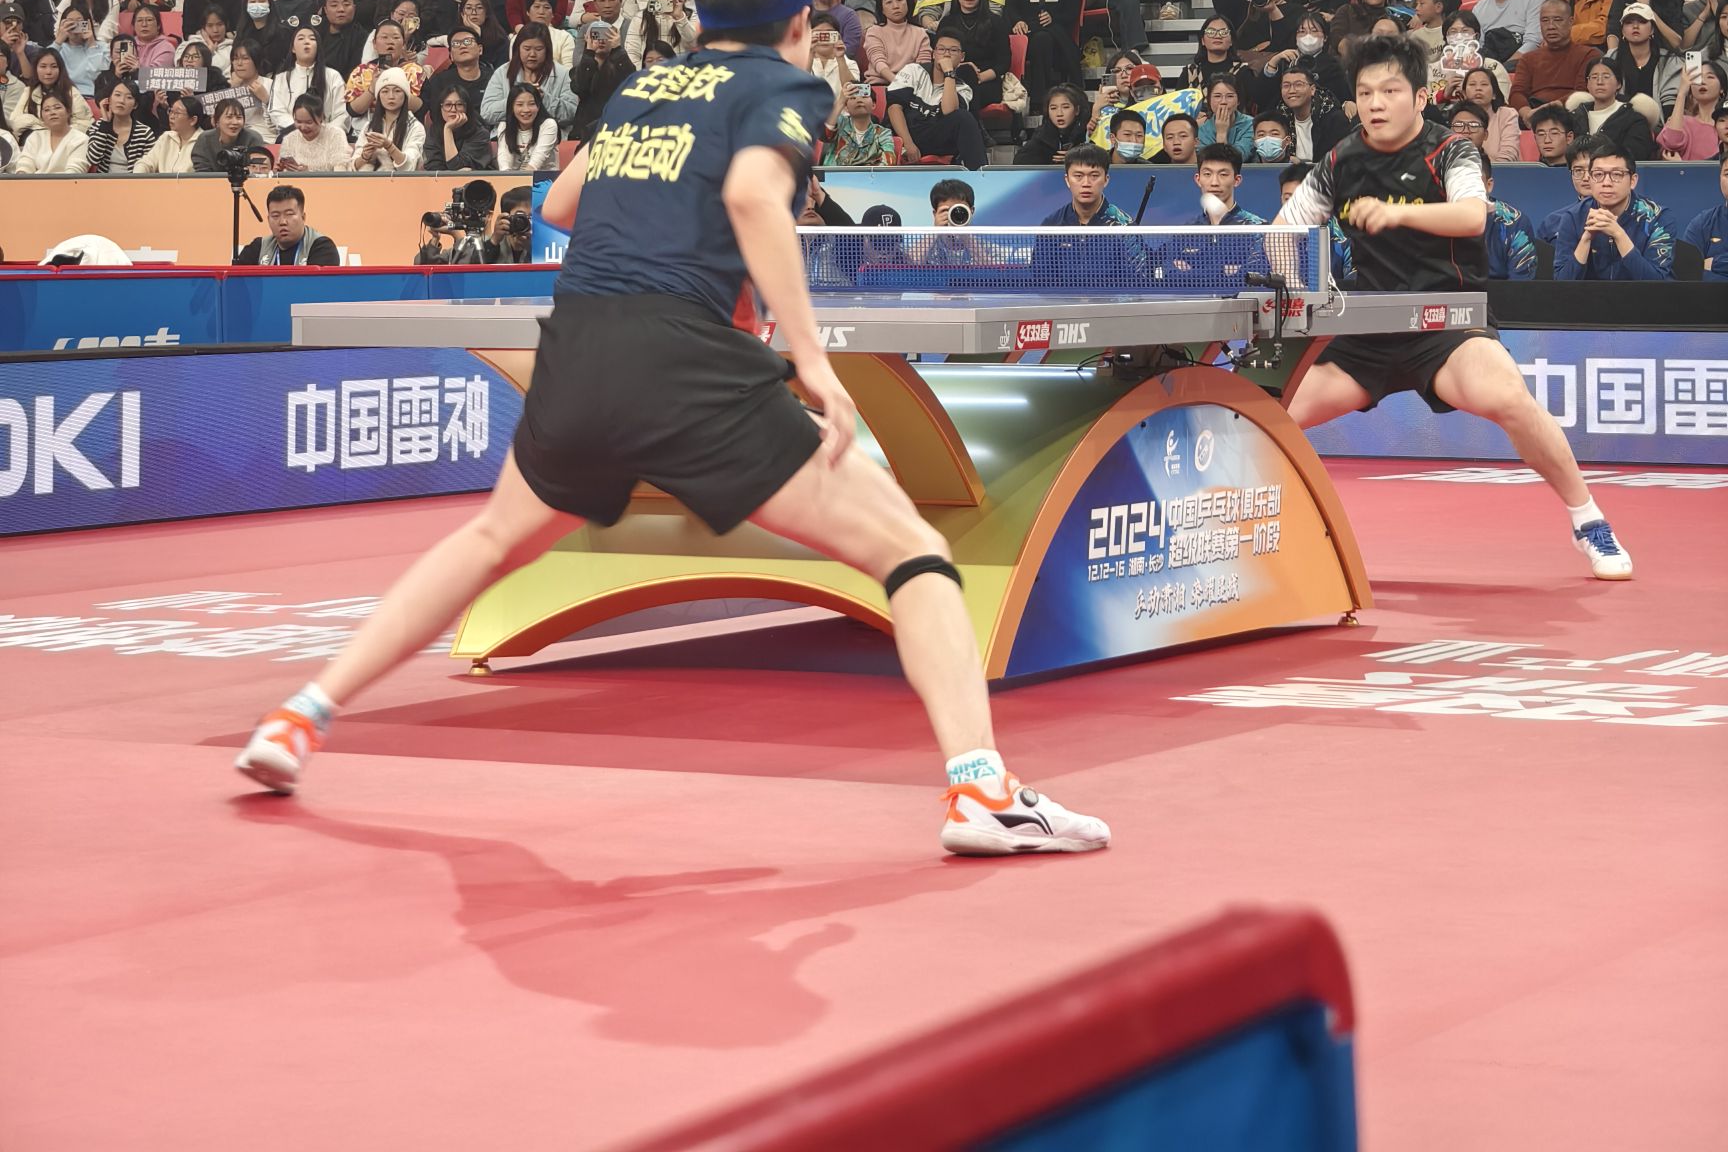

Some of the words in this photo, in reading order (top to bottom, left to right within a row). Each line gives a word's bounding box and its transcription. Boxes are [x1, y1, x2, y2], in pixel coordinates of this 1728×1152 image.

[621, 63, 736, 103] 王楚钦
[1018, 322, 1051, 349] 红双喜
[1056, 322, 1090, 345] DHS
[1450, 307, 1474, 325] DHS
[286, 374, 490, 473] 中国雷神
[1088, 499, 1168, 560] 2024
[1168, 484, 1282, 532] 中国乒乓球俱乐部
[1167, 520, 1281, 569] 超级联赛第一阶段
